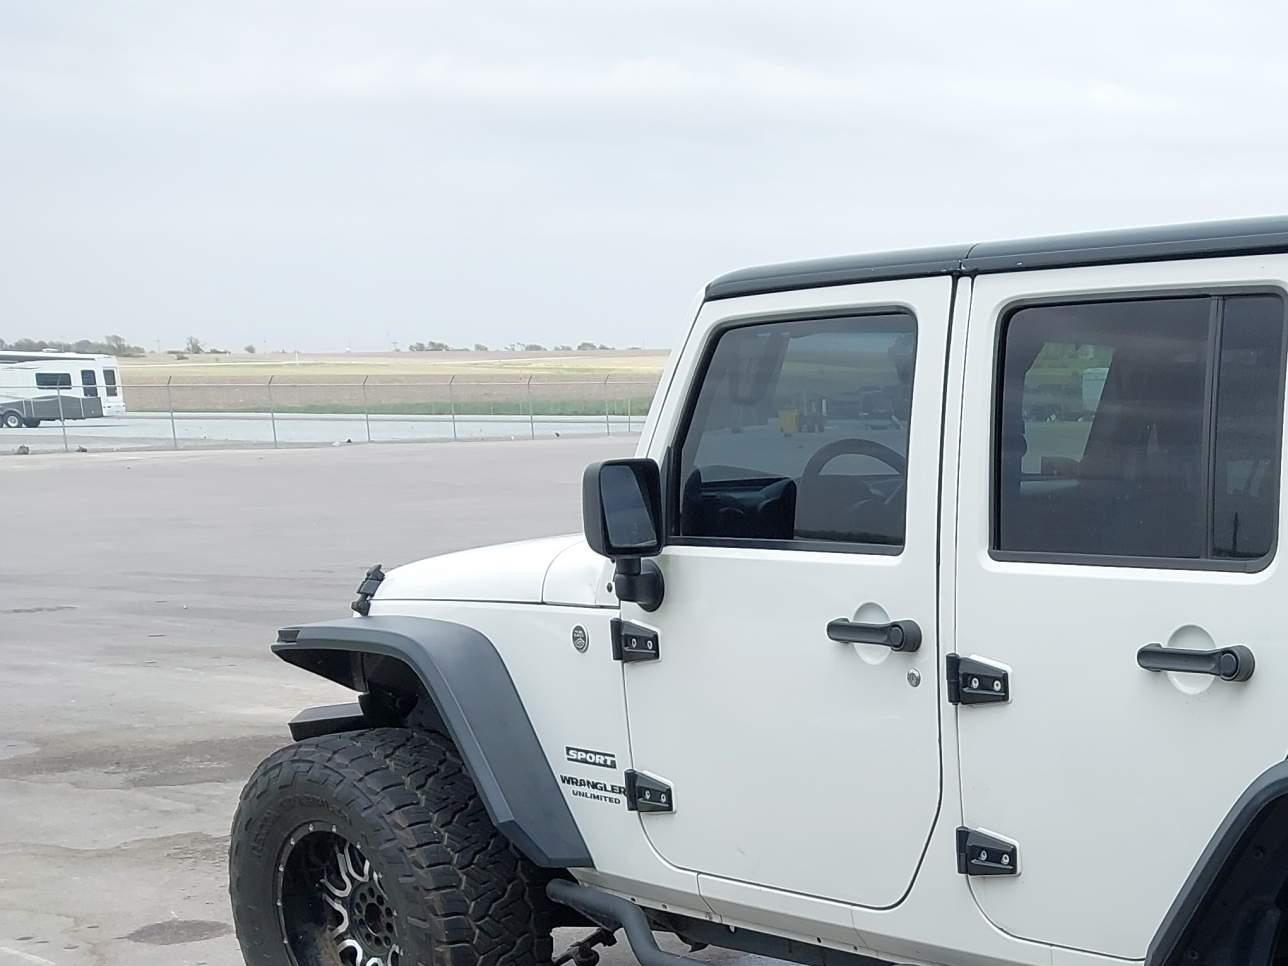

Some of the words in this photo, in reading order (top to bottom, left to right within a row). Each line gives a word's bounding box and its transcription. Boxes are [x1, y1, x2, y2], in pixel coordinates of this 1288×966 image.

[568, 749, 616, 766] SPORT
[560, 775, 627, 797] WRANGLER
[571, 789, 621, 805] UNLIMITED
